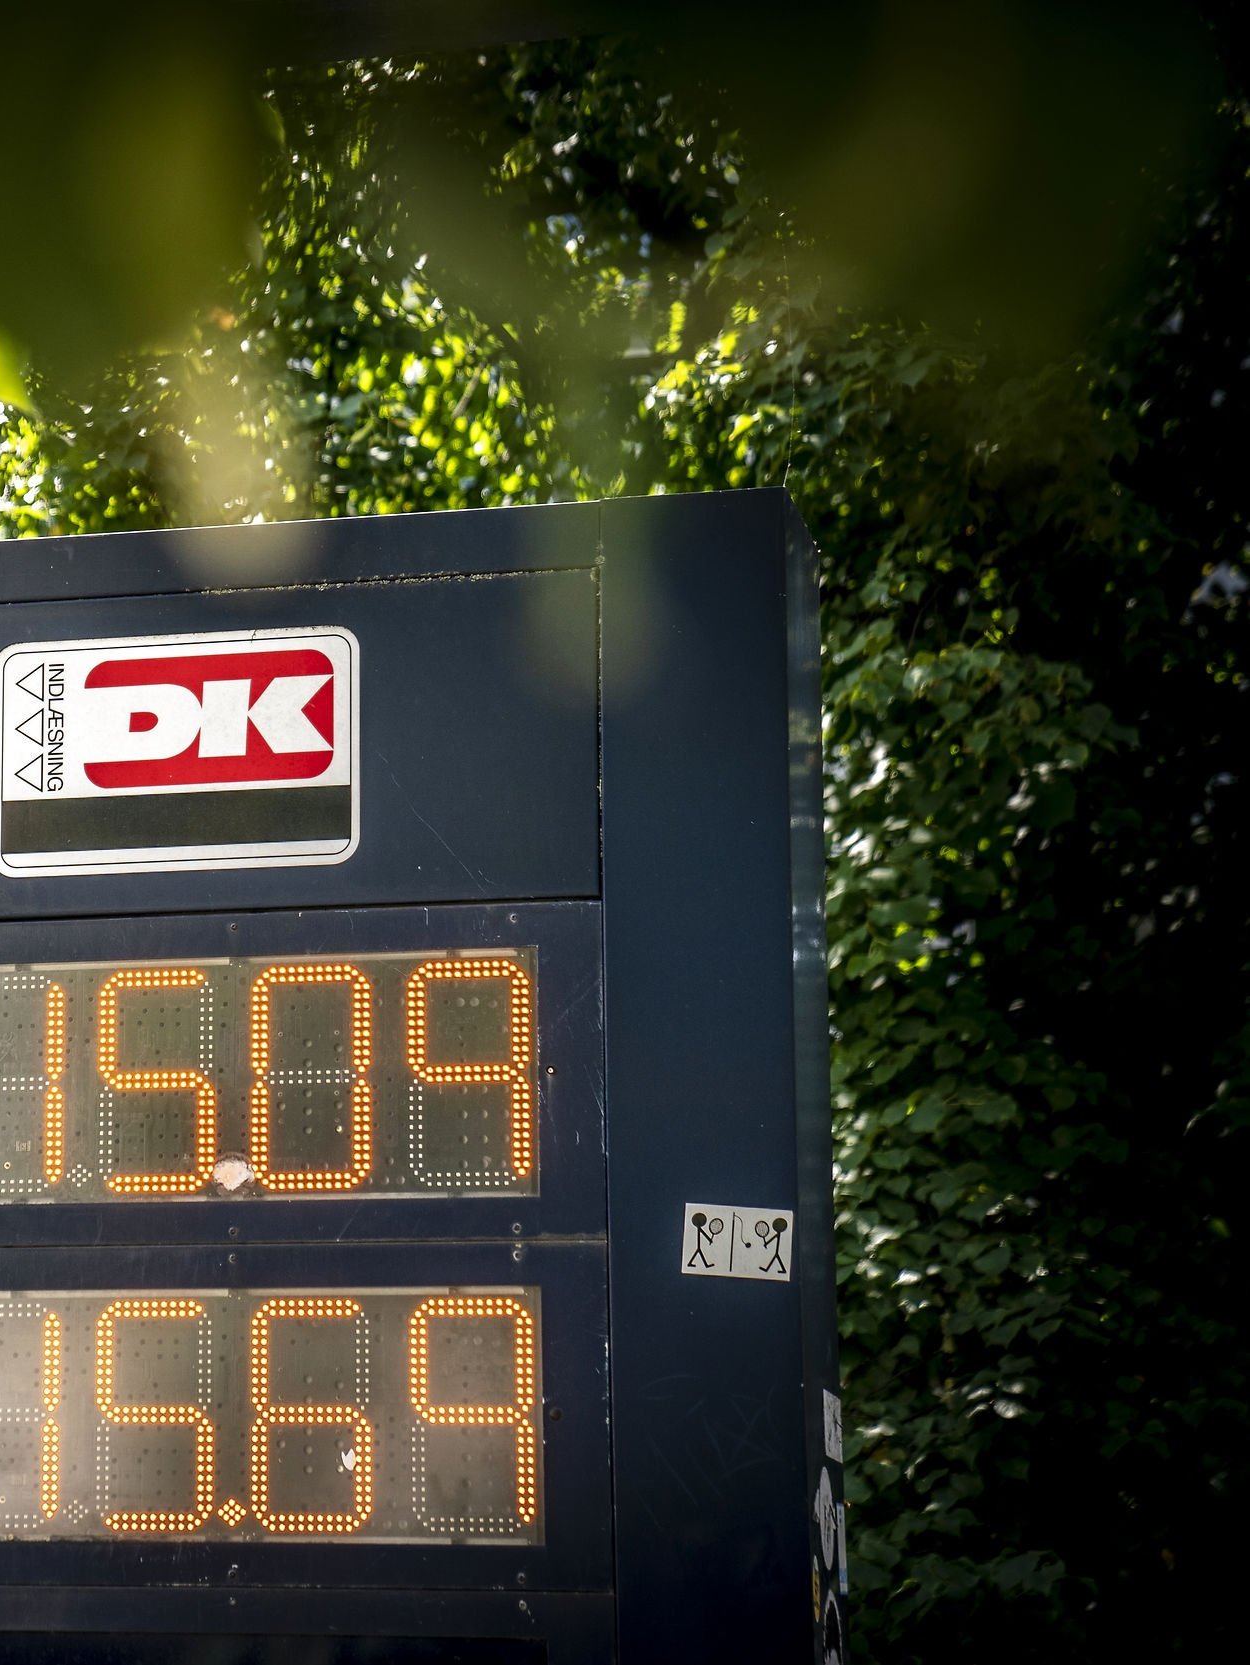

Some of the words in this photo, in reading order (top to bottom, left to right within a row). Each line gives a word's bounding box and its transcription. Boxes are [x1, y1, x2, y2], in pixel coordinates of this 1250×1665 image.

[46, 663, 65, 793] INDLÆSNING
[84, 672, 334, 765] DK
[45, 957, 532, 1195] 1509
[40, 1296, 535, 1533] 15.69
